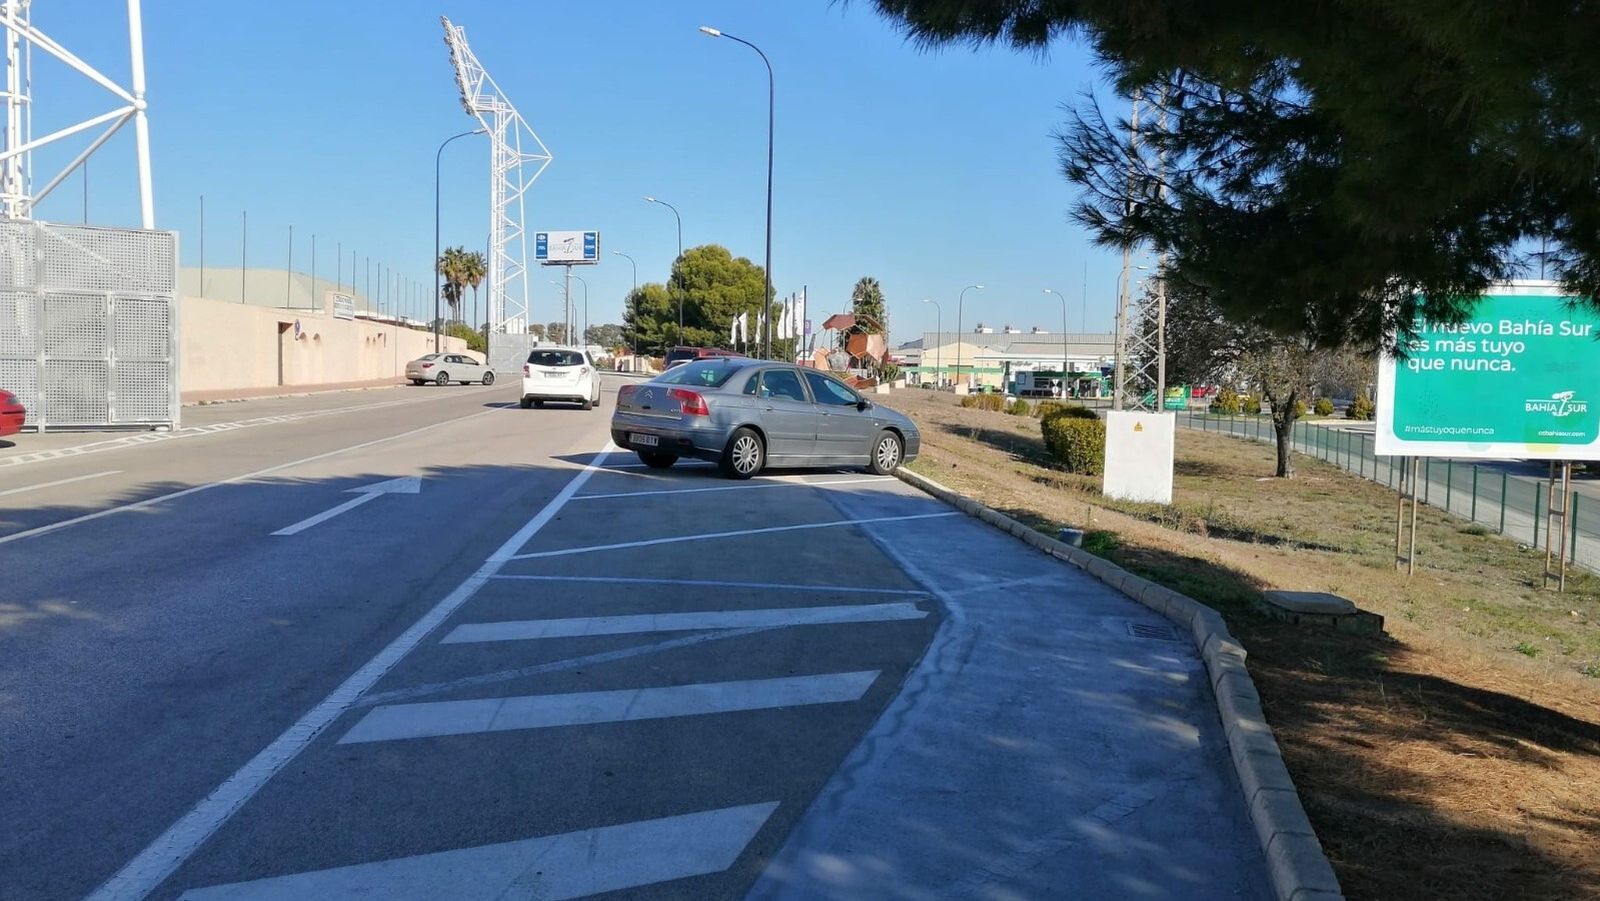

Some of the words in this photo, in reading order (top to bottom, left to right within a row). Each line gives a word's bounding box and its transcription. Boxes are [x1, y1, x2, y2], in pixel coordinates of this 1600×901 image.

[1410, 318, 1427, 333] El
[1433, 321, 1493, 334] nuevo
[1499, 319, 1553, 335] Bahía
[1559, 320, 1592, 336] Sur
[1409, 339, 1430, 352] es
[1436, 336, 1476, 352] más
[1481, 338, 1525, 356] tuyo
[1407, 357, 1445, 372] que
[1451, 357, 1516, 372] nunca.
[1568, 402, 1587, 413] SUR
[1405, 425, 1495, 436] #mástuyoquenunca
